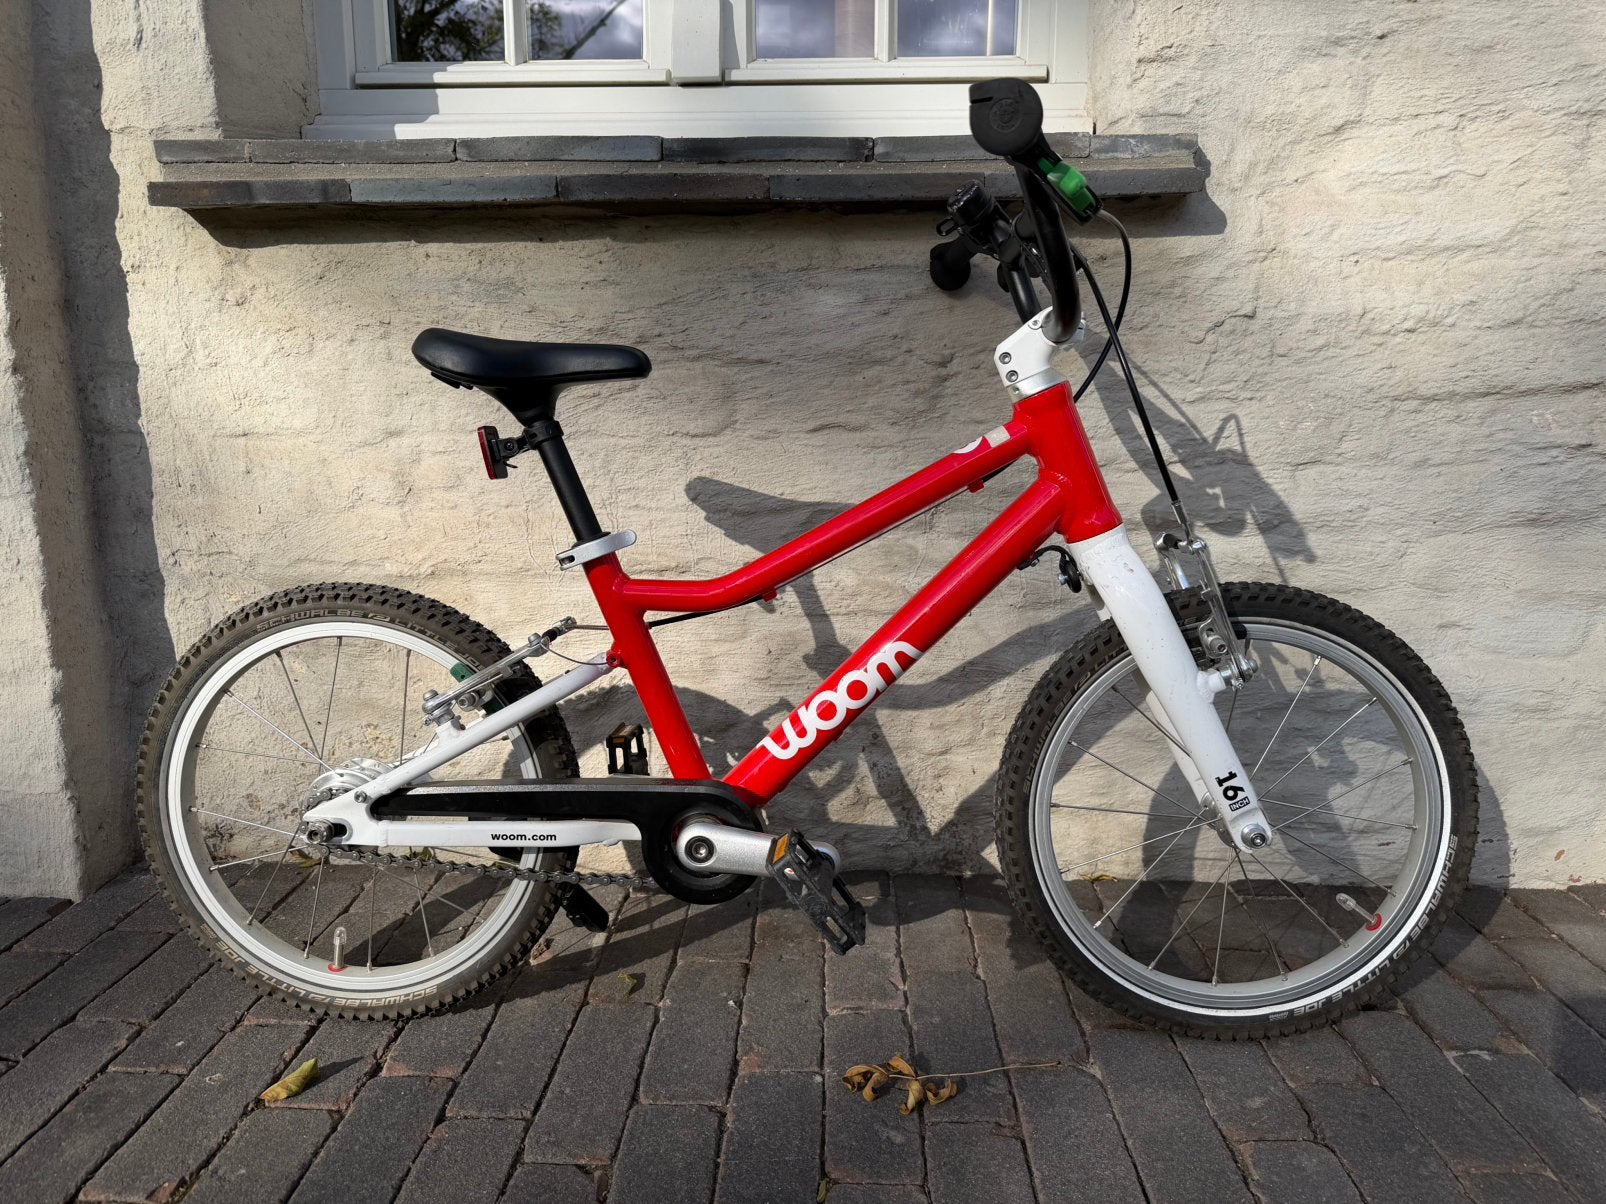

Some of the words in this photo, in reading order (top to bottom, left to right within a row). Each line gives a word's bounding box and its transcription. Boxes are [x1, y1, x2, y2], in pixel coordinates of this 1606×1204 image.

[755, 641, 924, 760] woom
[1215, 770, 1246, 801] 16
[1230, 796, 1250, 812] INCH
[490, 833, 557, 841] woom.com
[1410, 833, 1459, 937] SCHWALBE
[246, 964, 305, 997] LITTLE
[1332, 960, 1391, 1001] LITTLE
[333, 985, 438, 1008] SCHWALBE
[1294, 997, 1327, 1016] JOE
